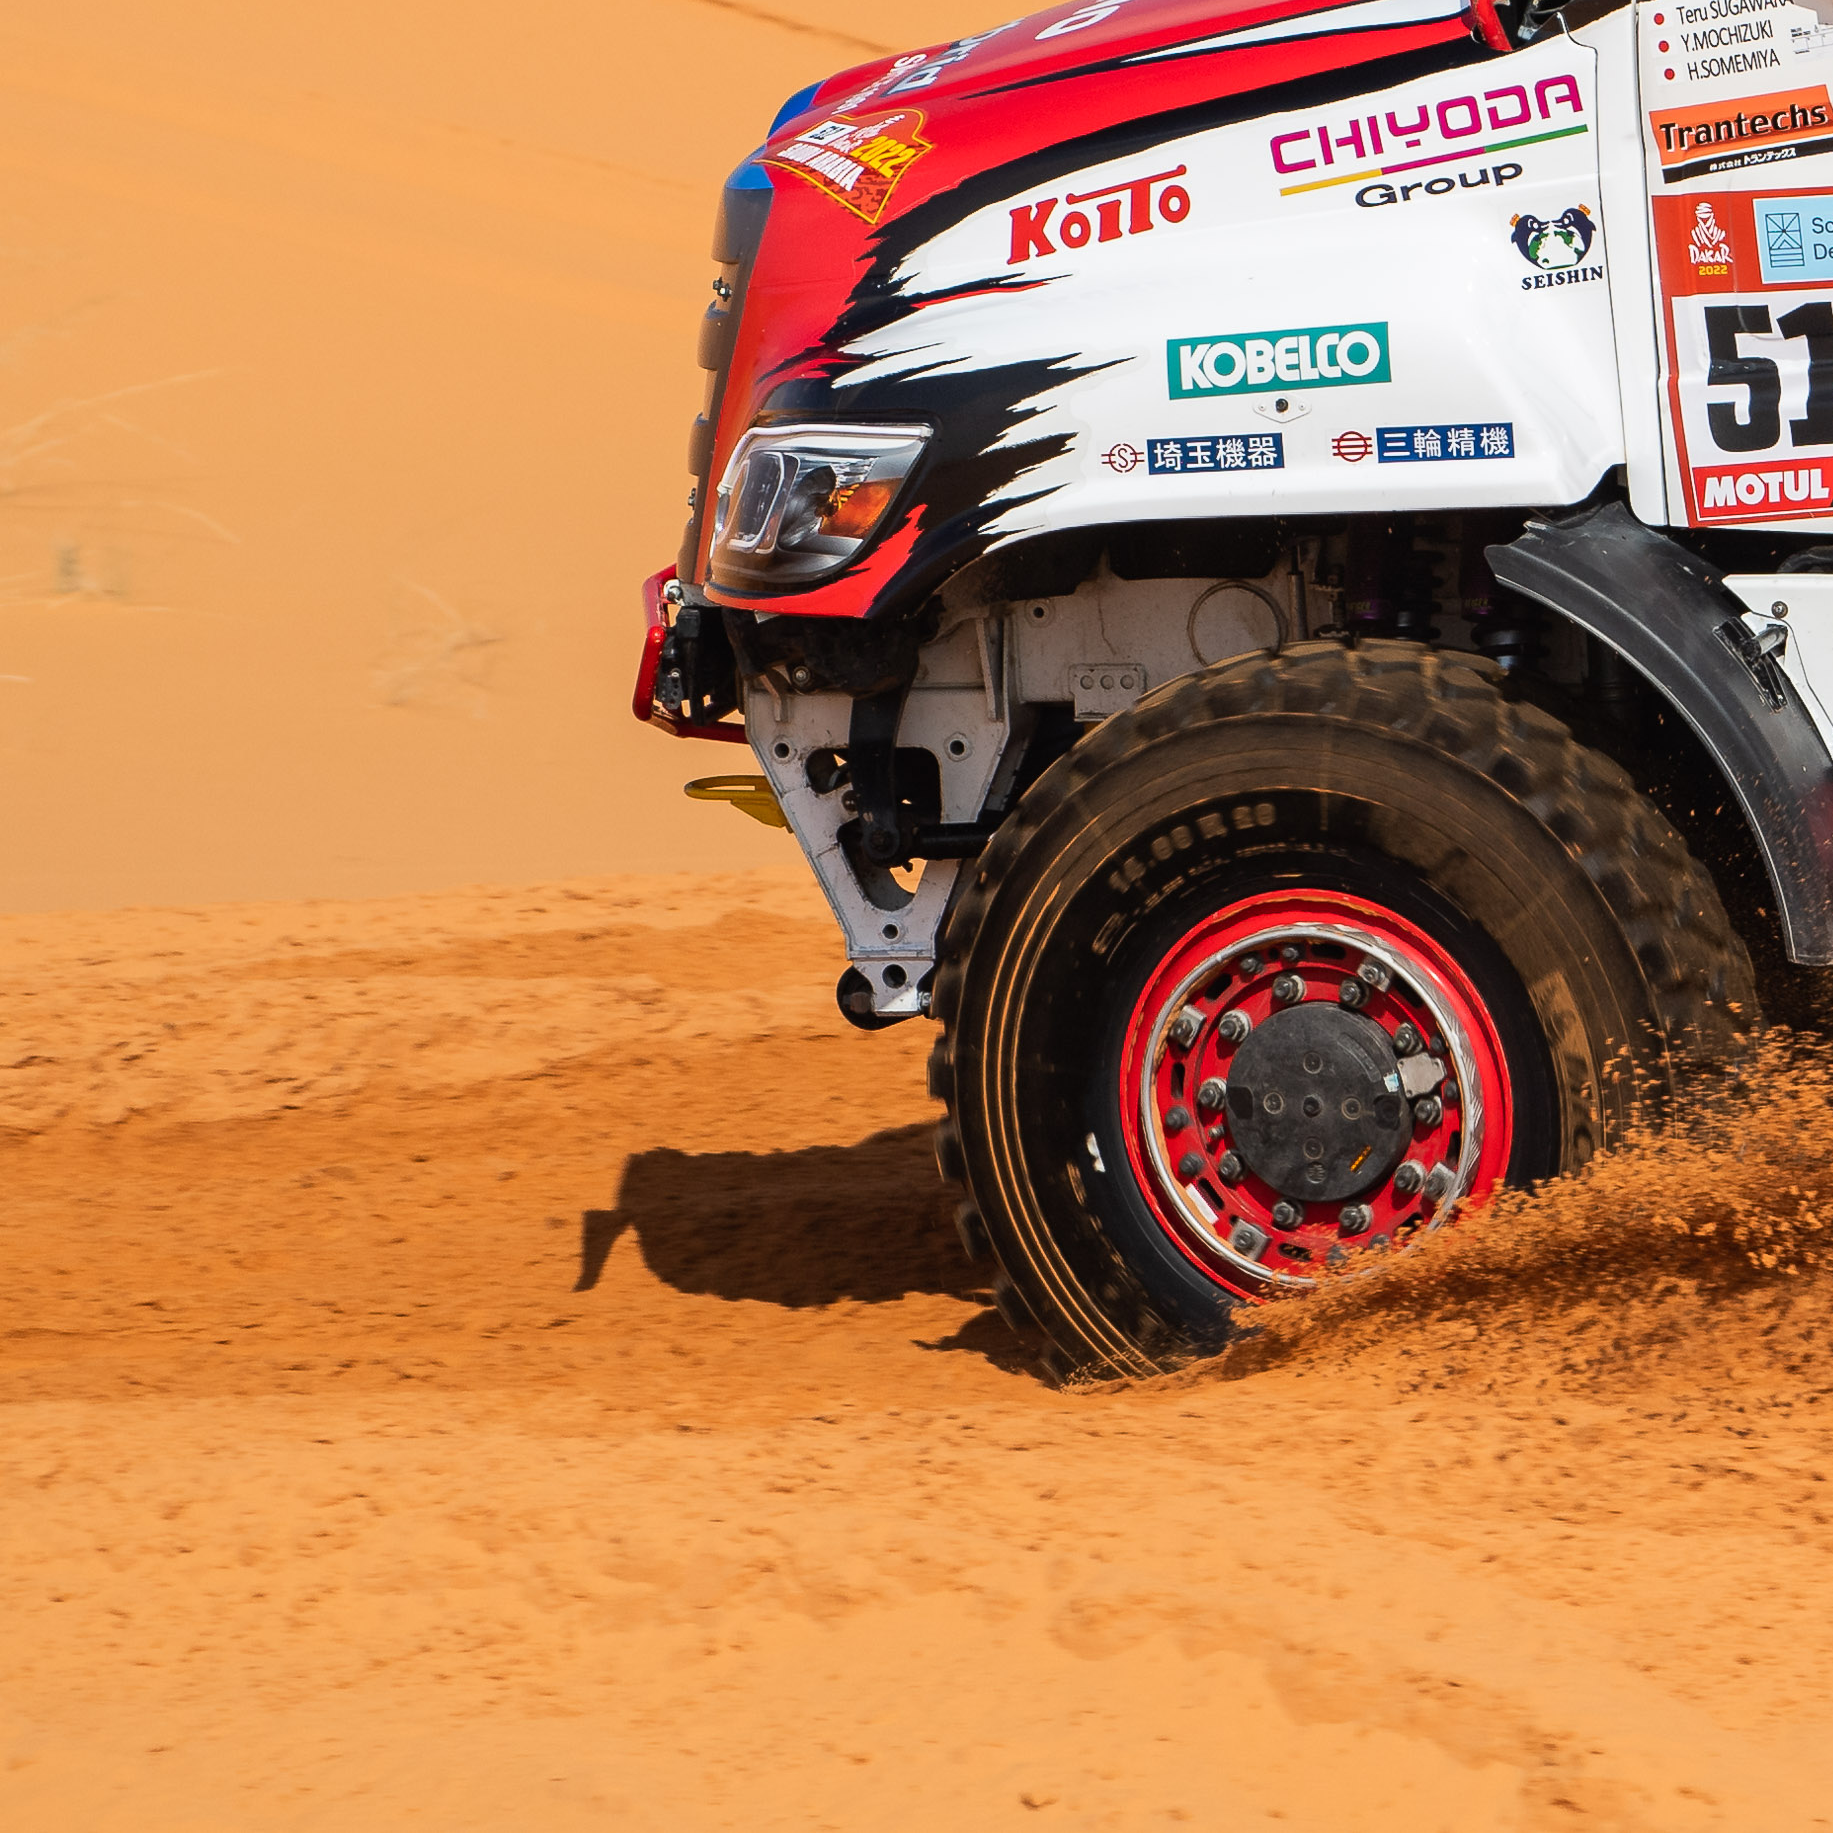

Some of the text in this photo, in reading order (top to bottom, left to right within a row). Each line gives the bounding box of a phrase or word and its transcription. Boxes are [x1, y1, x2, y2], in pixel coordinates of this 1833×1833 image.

[1677, 4, 1708, 26] Teru
[1681, 19, 1775, 54] Y.MOCHIZUKI
[1687, 48, 1781, 82] H.SOMEMIYA
[1269, 73, 1584, 175] CHIYODA
[1659, 102, 1829, 154] Trantechs
[1354, 160, 1524, 210] Group
[1688, 245, 1734, 265] DAKAR
[1698, 264, 1729, 276] 2022
[1520, 264, 1604, 292] SEISHIN
[1178, 329, 1382, 392] KOBELCO
[1152, 435, 1279, 472] 埼玉機器
[1381, 426, 1512, 458] 三輪精機
[1703, 468, 1832, 509] MOTUL
